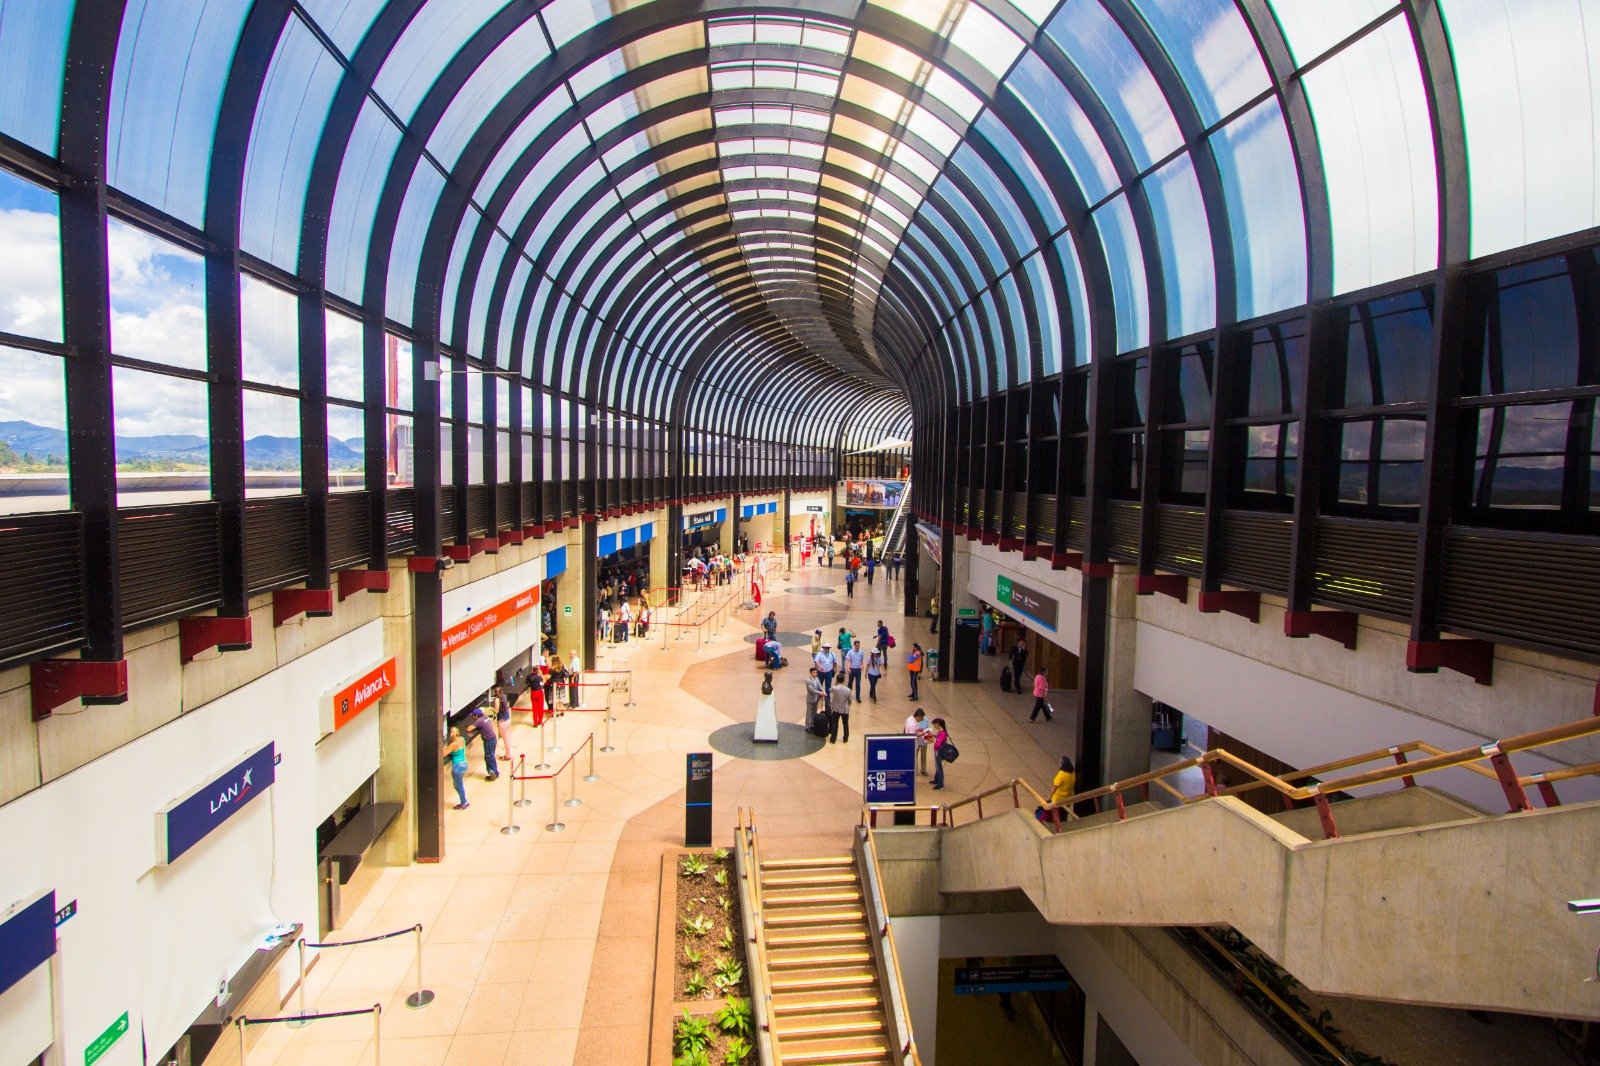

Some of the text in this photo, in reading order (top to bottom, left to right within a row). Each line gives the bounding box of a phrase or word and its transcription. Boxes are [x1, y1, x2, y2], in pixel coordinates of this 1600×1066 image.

[447, 629, 467, 647] Ventas
[470, 621, 484, 636] Sales
[483, 613, 498, 628] Office
[354, 677, 383, 707] Avianca
[210, 782, 238, 814] LAN
